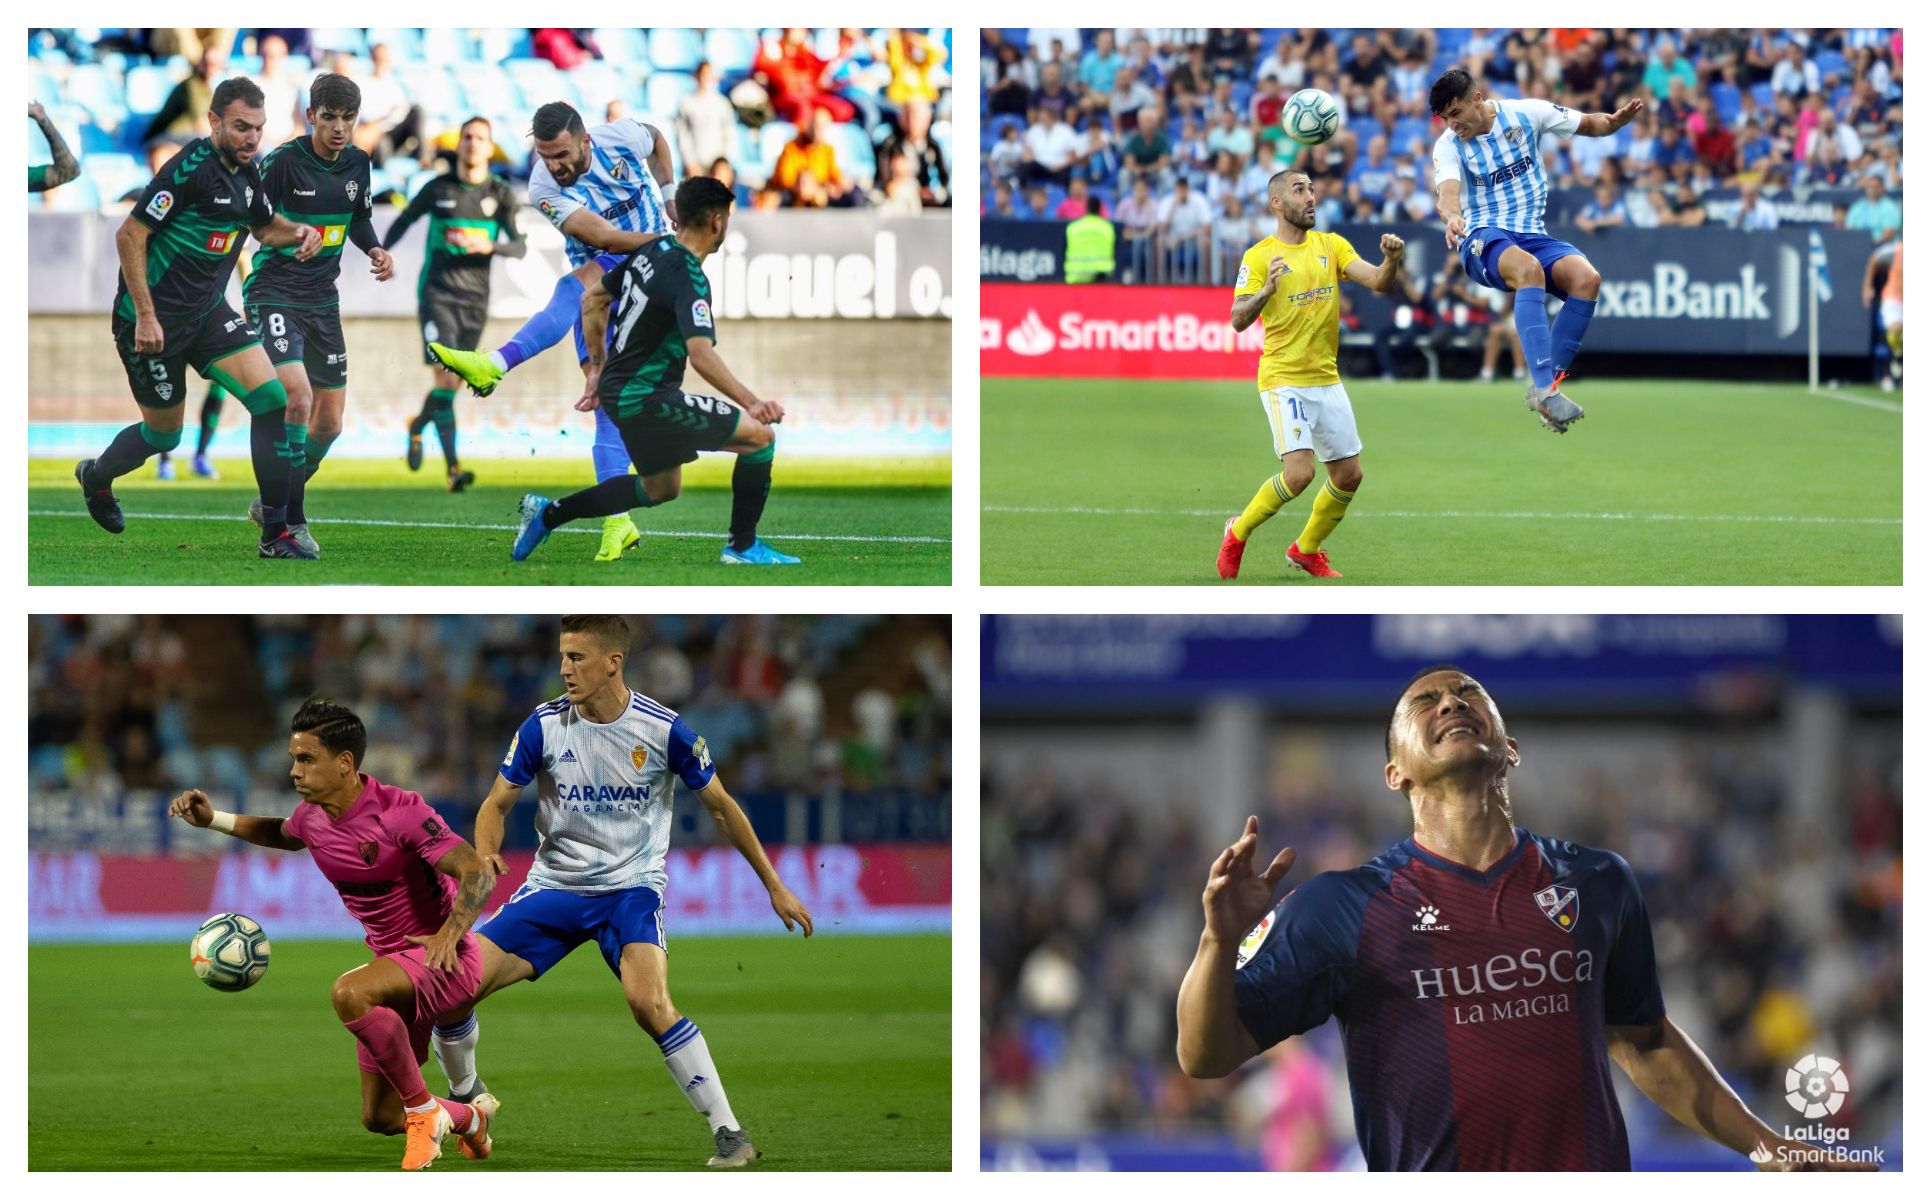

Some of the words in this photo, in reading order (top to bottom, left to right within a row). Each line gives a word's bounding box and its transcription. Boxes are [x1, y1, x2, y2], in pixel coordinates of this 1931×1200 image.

[1595, 262, 1771, 319] xaBank
[268, 313, 286, 337] 8
[149, 358, 168, 381] 5
[557, 783, 650, 802] CARAVAN
